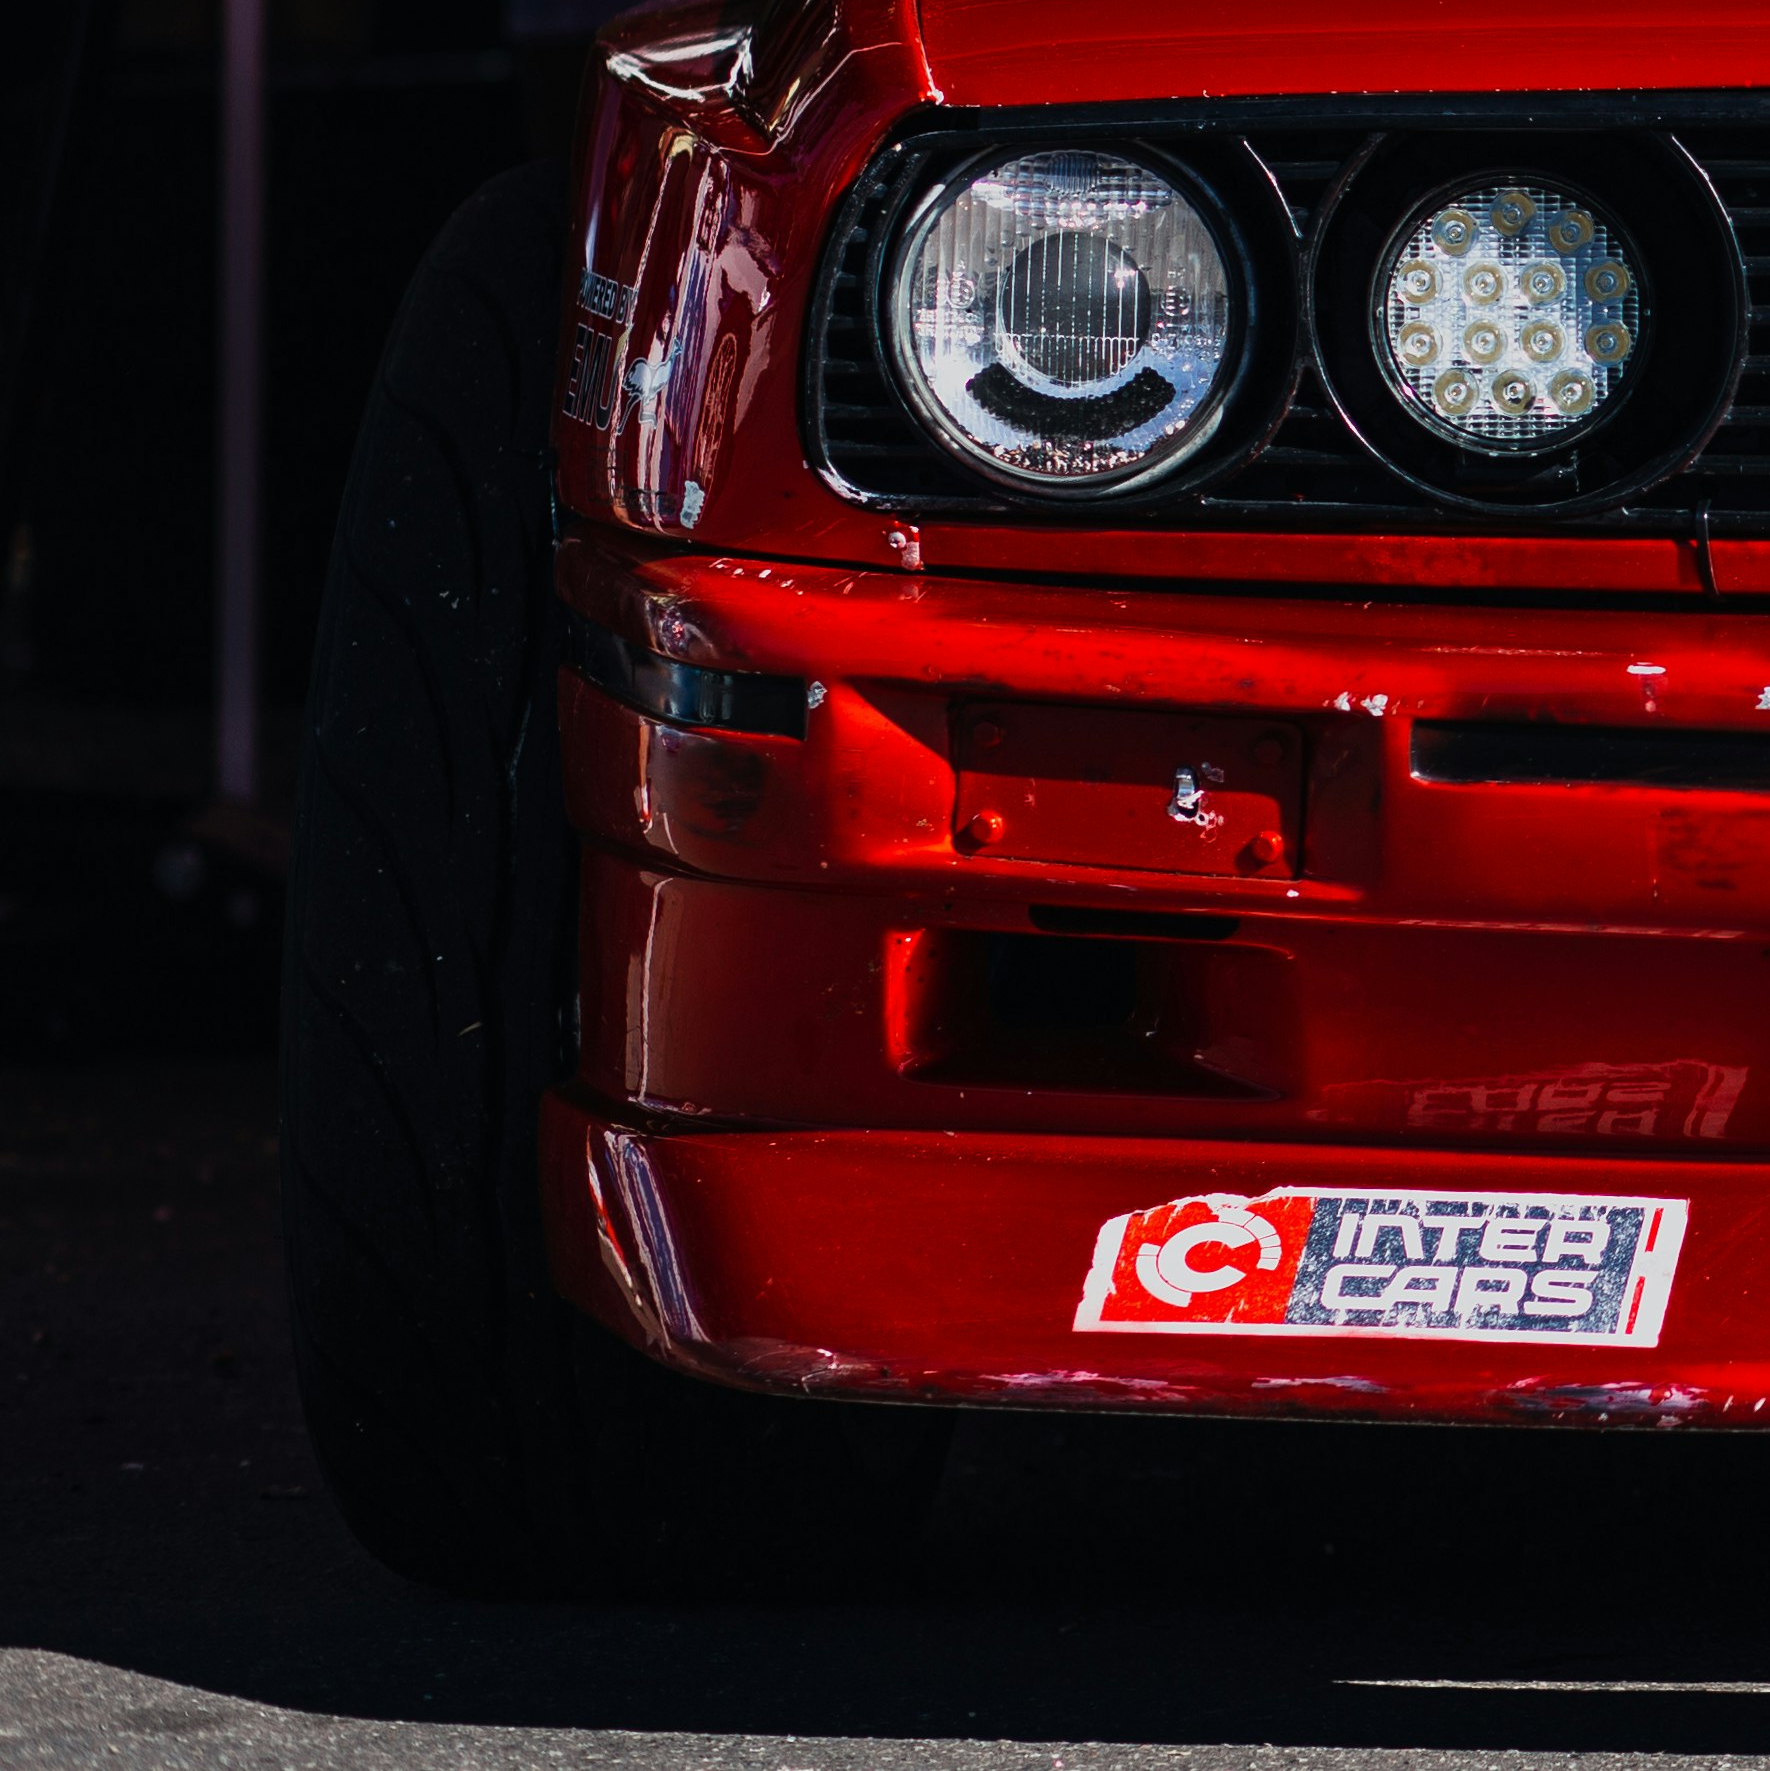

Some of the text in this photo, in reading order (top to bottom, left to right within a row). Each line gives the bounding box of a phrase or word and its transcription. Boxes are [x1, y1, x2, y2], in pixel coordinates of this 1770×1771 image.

[562, 322, 629, 431] EMU
[1332, 1211, 1613, 1263] INTER
[1320, 1264, 1594, 1316] CARS
